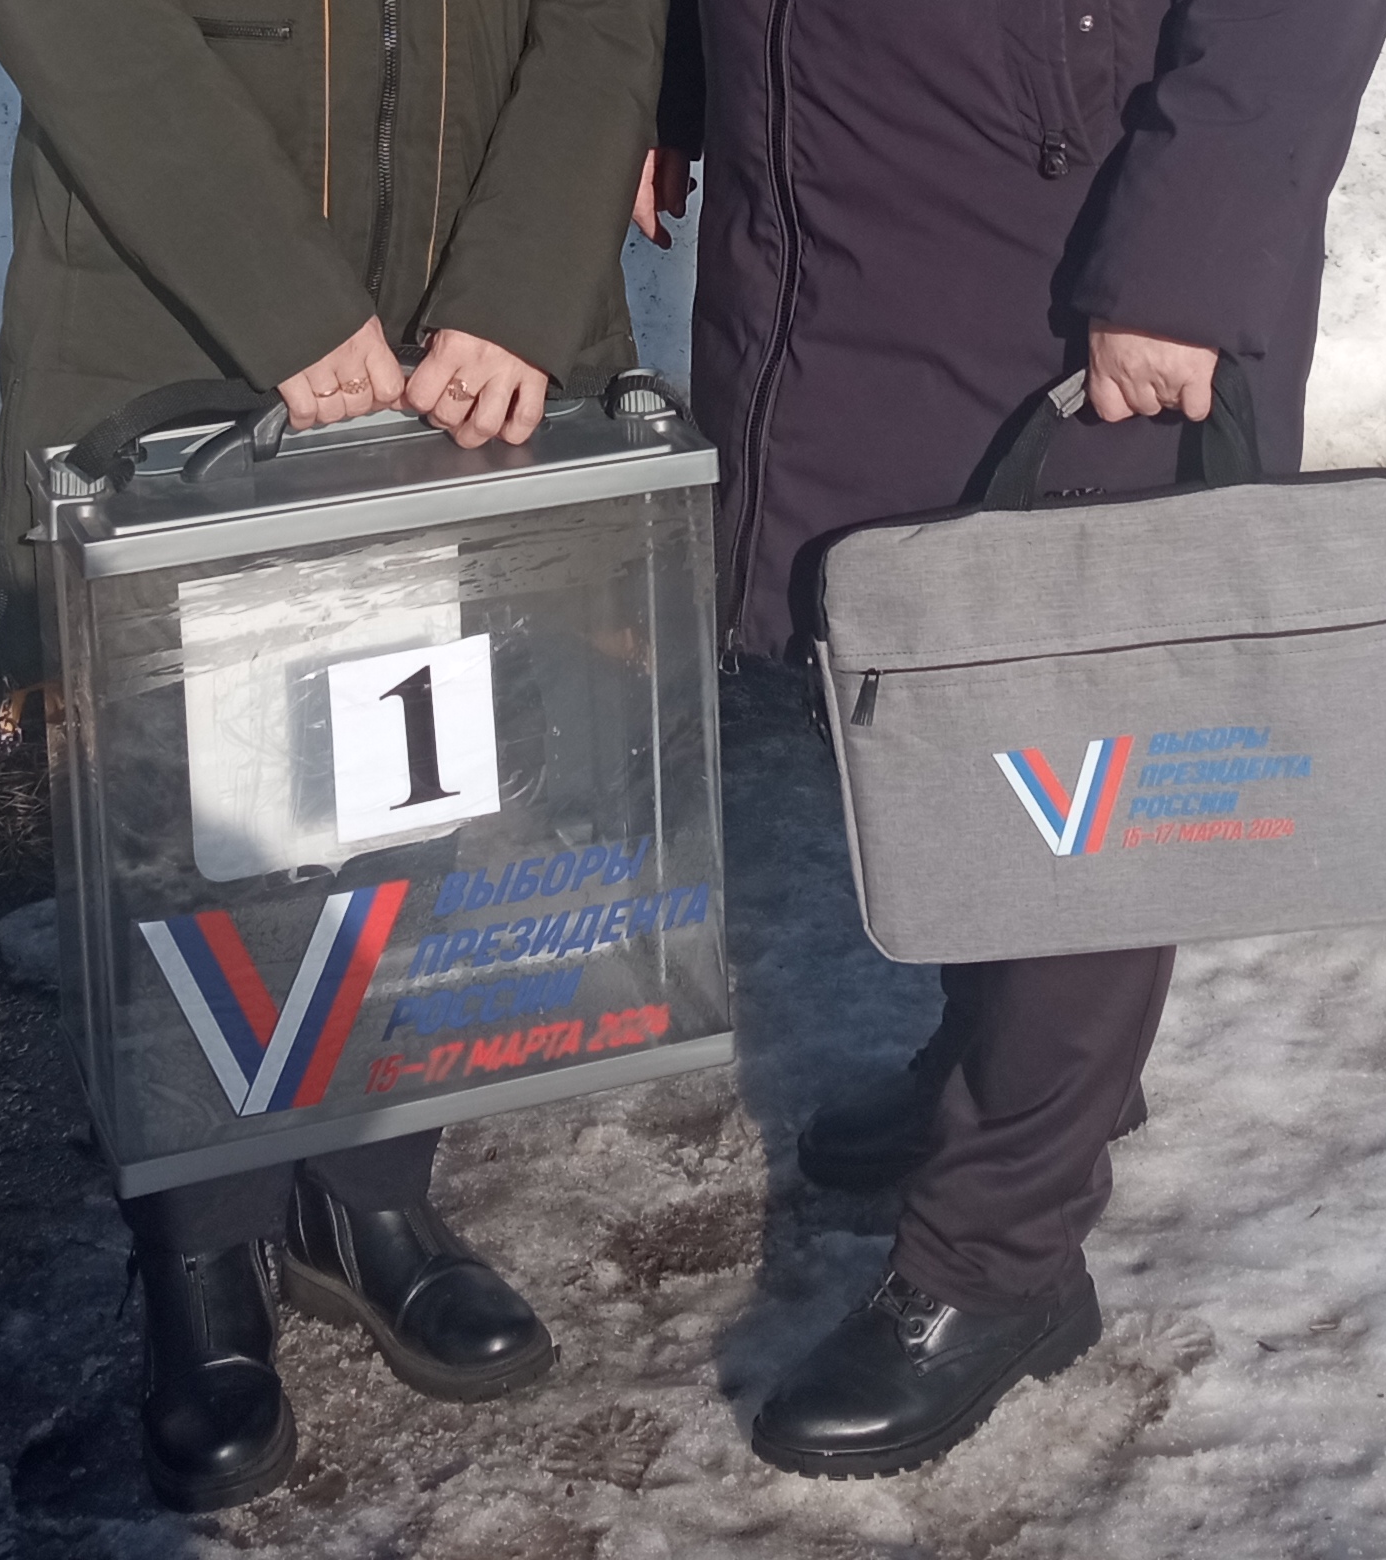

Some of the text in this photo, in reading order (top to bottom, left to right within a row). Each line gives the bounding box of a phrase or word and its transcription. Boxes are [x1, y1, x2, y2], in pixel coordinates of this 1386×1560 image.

[379, 664, 461, 811] 1
[1147, 726, 1271, 755] ВЫБОРЫ
[1138, 755, 1312, 788] ПРЕЗИДЕНТА
[1128, 791, 1240, 820] РОССИИ
[1177, 820, 1243, 843] МАРТА
[1247, 817, 1295, 840] 2024
[433, 835, 652, 918] ВЫБОРЫ
[408, 882, 710, 980] ПРЕЗИДЕНТА
[382, 965, 585, 1041] РОССИИ
[464, 1019, 585, 1076] МАРТА
